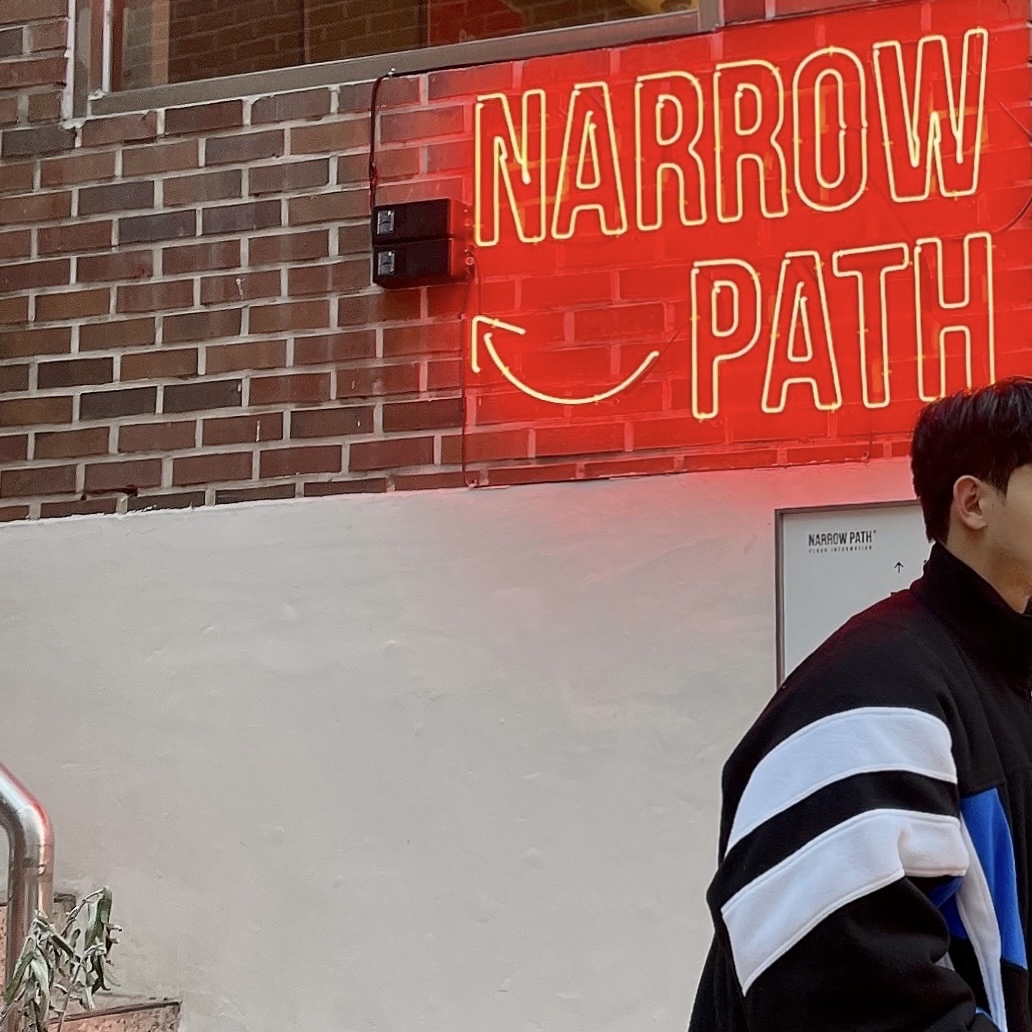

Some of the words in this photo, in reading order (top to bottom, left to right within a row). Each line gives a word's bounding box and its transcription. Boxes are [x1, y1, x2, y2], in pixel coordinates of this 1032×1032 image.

[474, 28, 989, 247] NARROW
[691, 232, 995, 419] PATH
[808, 532, 847, 546] NARROW
